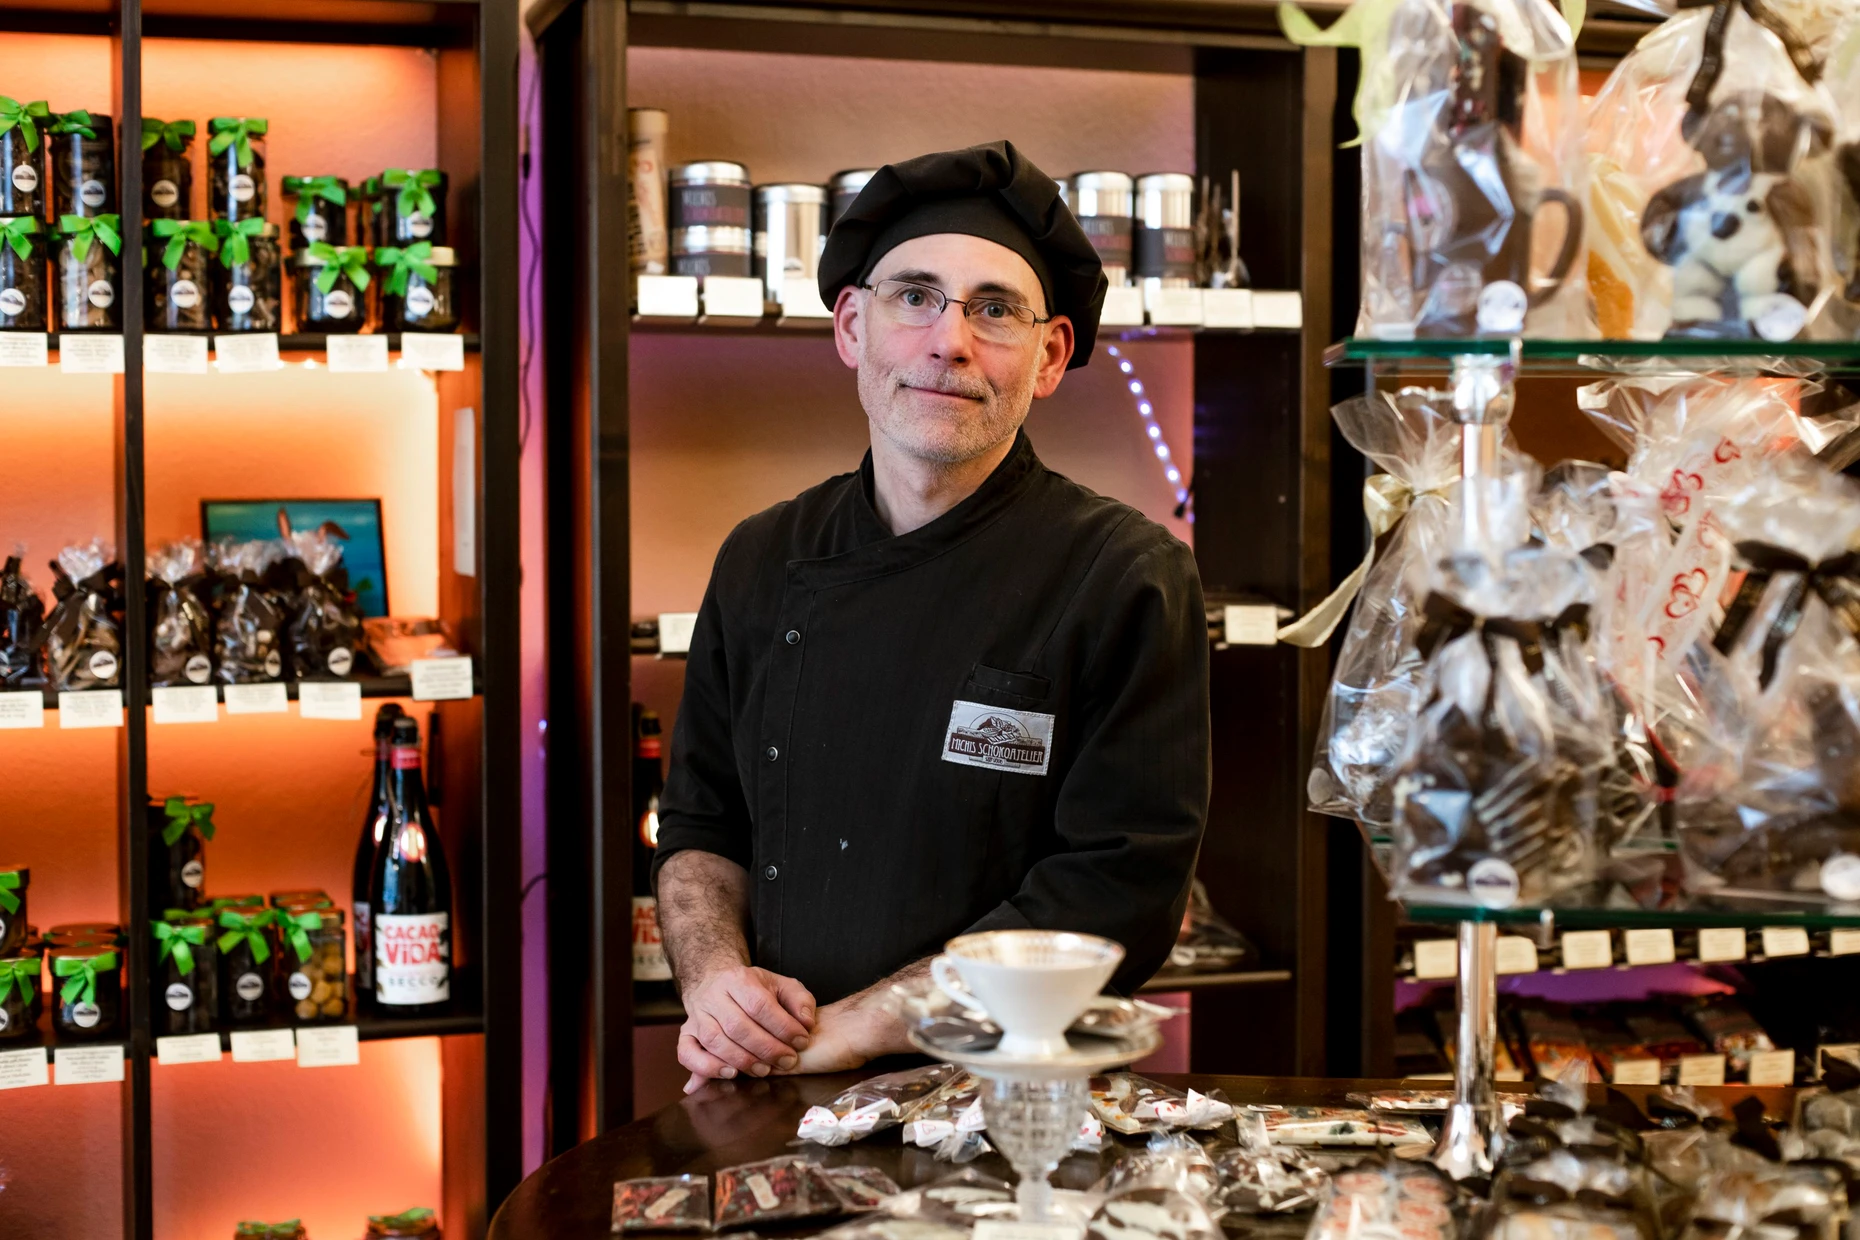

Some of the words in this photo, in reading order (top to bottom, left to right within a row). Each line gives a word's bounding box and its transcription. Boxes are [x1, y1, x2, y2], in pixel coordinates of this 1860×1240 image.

[951, 738, 976, 753] MICHIS
[978, 743, 1043, 763] SCHOKOATELIER
[385, 924, 440, 940] CACAO
